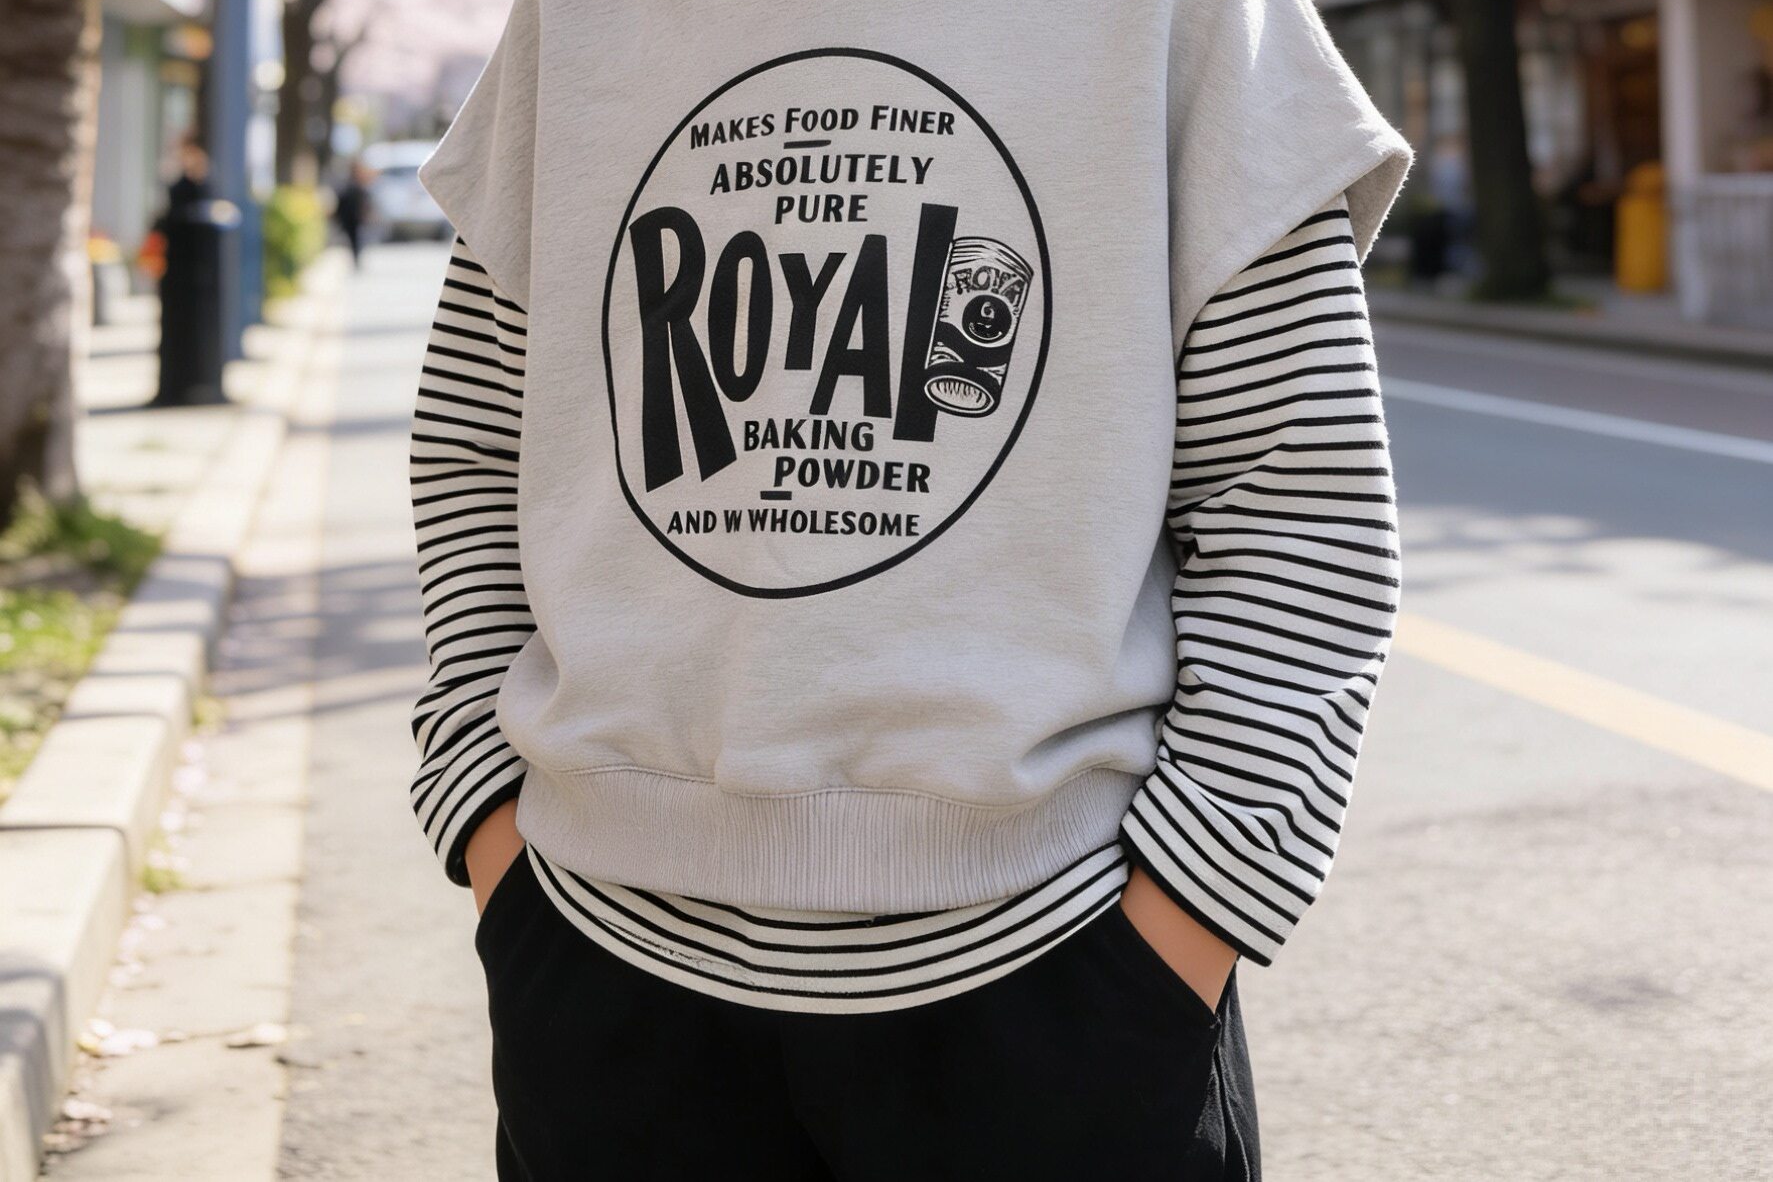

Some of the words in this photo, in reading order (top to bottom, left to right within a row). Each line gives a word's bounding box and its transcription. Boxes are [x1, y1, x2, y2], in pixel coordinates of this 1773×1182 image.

[690, 112, 775, 150] MAKES
[784, 107, 859, 134] FOOD
[870, 104, 956, 136] FINER
[709, 153, 935, 196] ABSOLUTELY
[774, 193, 869, 225] PURE
[743, 417, 875, 452] BAKING
[773, 455, 931, 494] POWDER
[666, 509, 718, 535] AND
